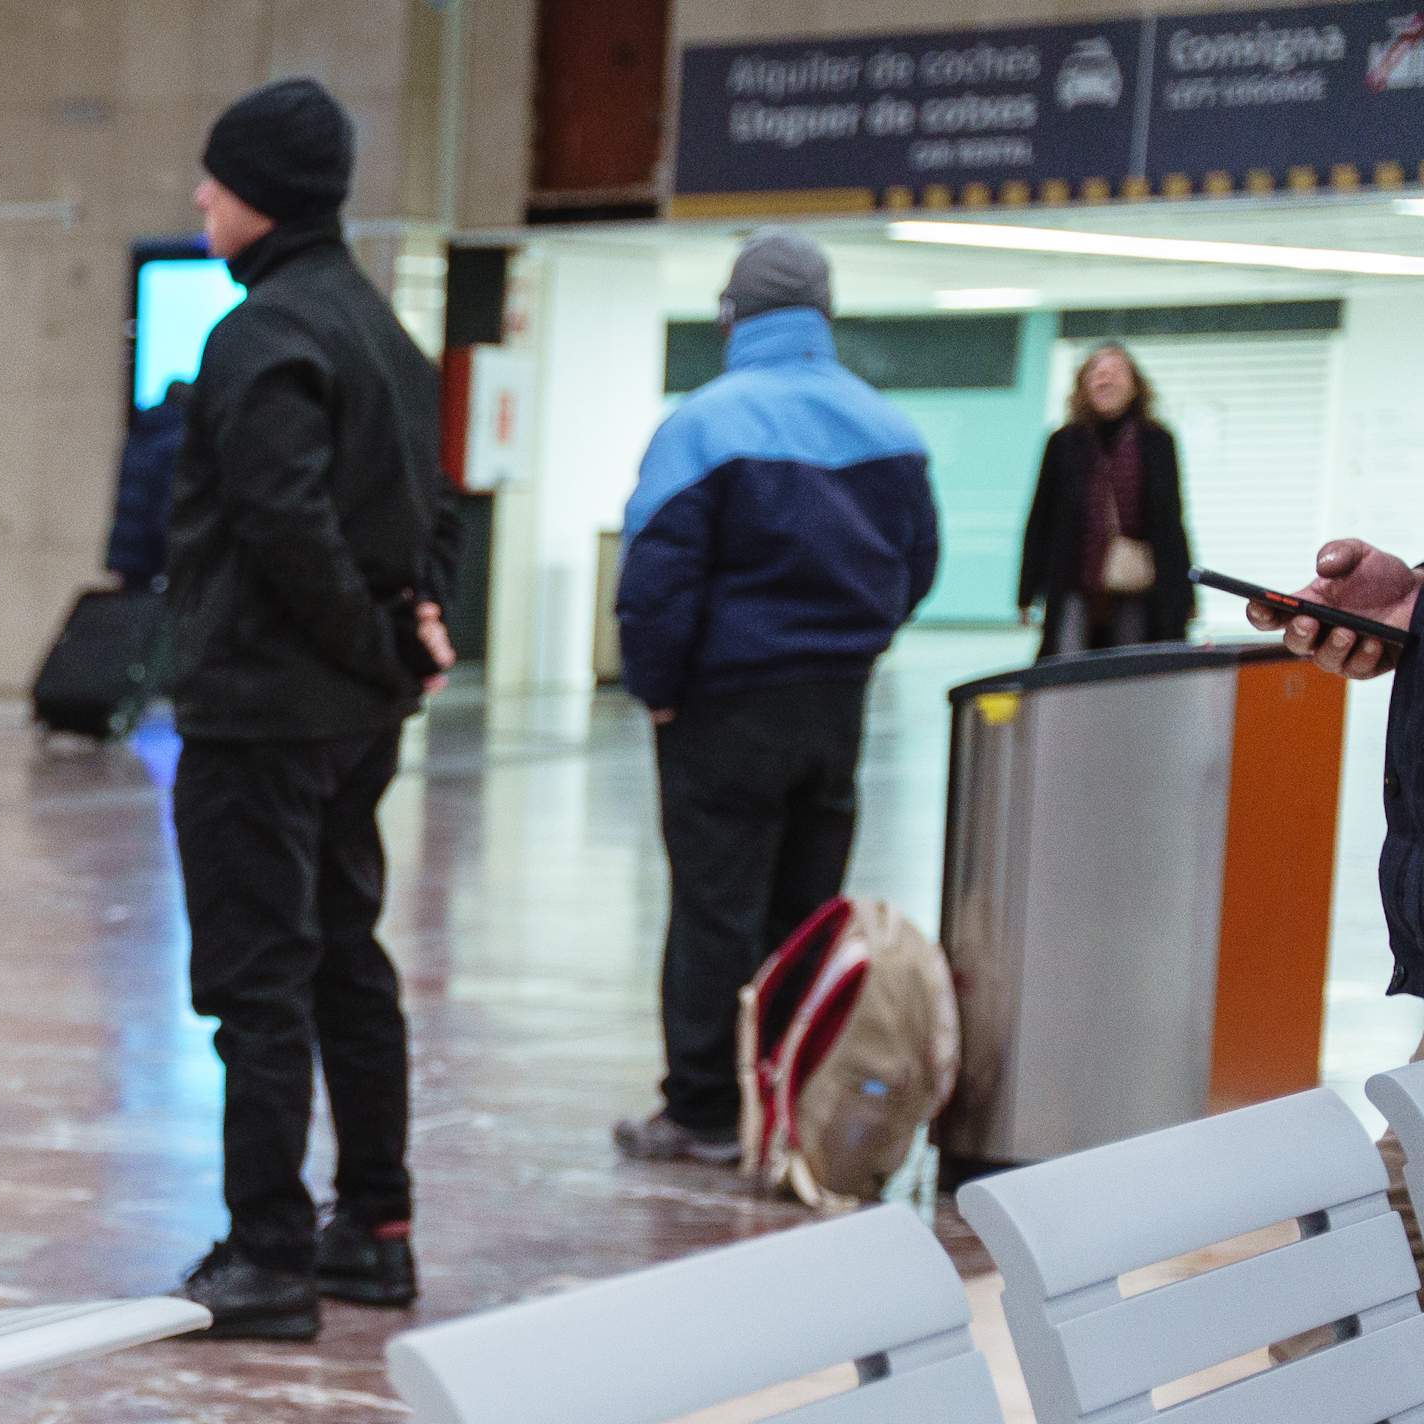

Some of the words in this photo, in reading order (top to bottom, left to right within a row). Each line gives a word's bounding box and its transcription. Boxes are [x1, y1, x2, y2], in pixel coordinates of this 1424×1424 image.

[1169, 22, 1346, 71] Consigna
[727, 55, 860, 99] Alquiler
[865, 48, 915, 88] de
[920, 45, 1041, 86] coches
[865, 96, 914, 135] de
